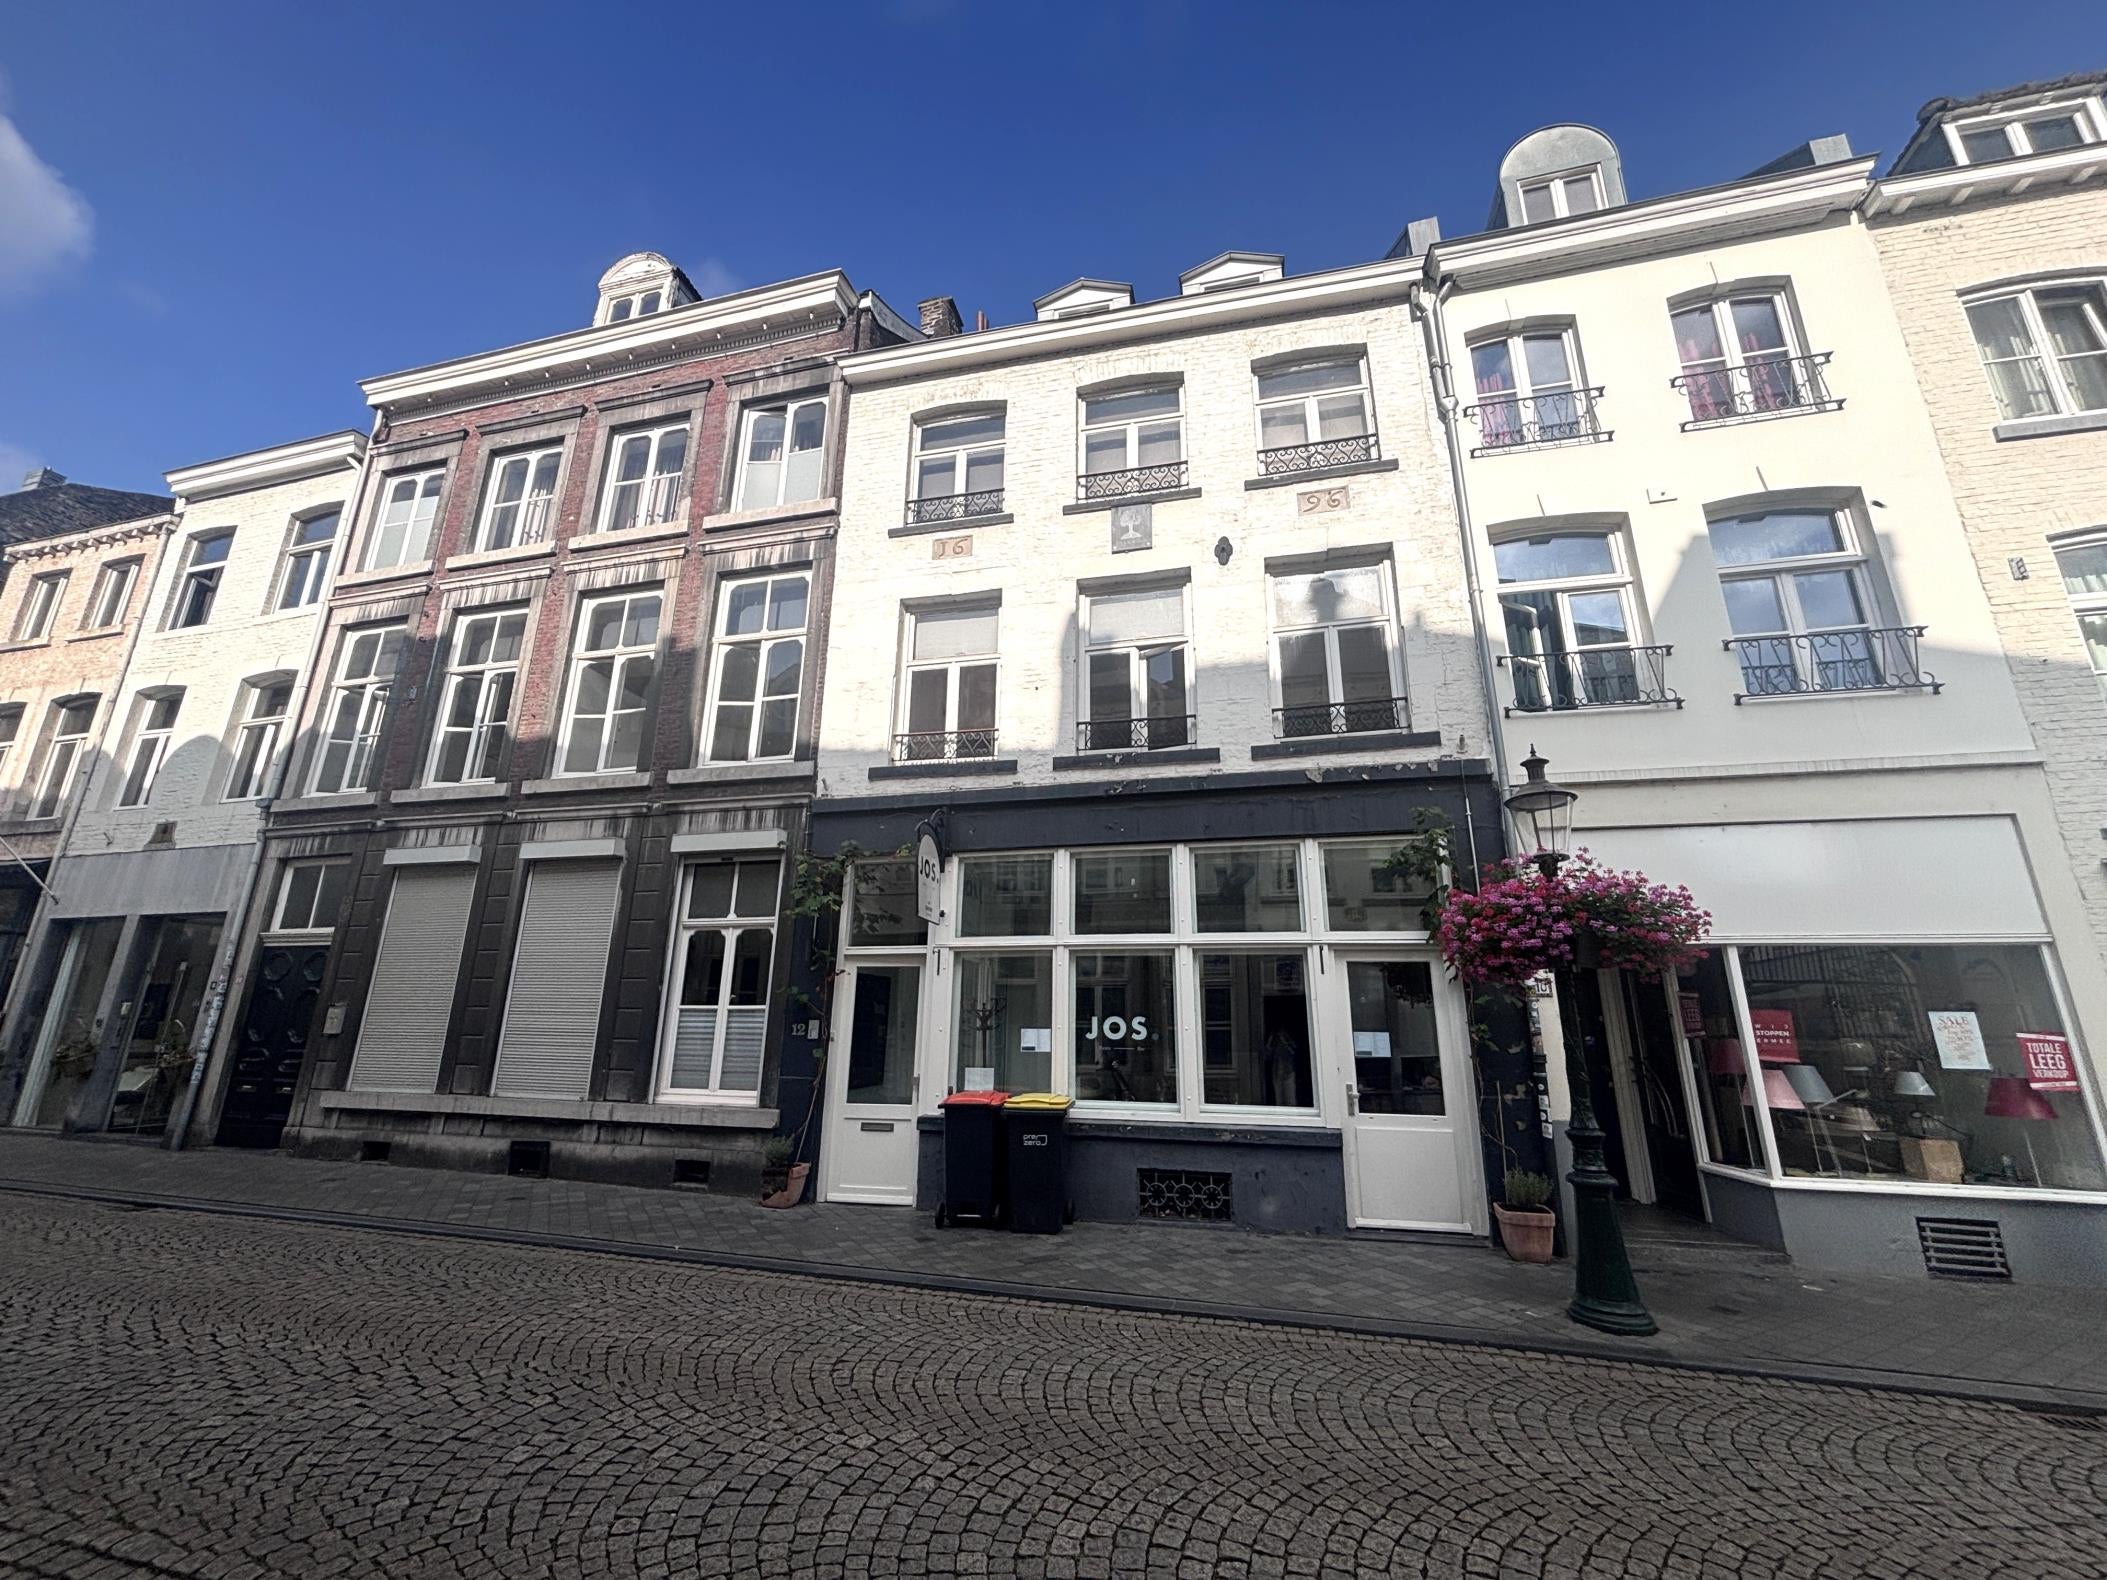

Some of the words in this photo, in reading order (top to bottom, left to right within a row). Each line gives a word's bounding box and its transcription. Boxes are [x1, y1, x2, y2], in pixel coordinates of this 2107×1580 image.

[1302, 490, 1343, 512] 96
[920, 855, 939, 884] JOS.
[791, 1023, 806, 1036] 12
[1085, 1015, 1160, 1041] JOS.
[2025, 1042, 2062, 1054] TOTALE
[2029, 1053, 2067, 1070] LEEG
